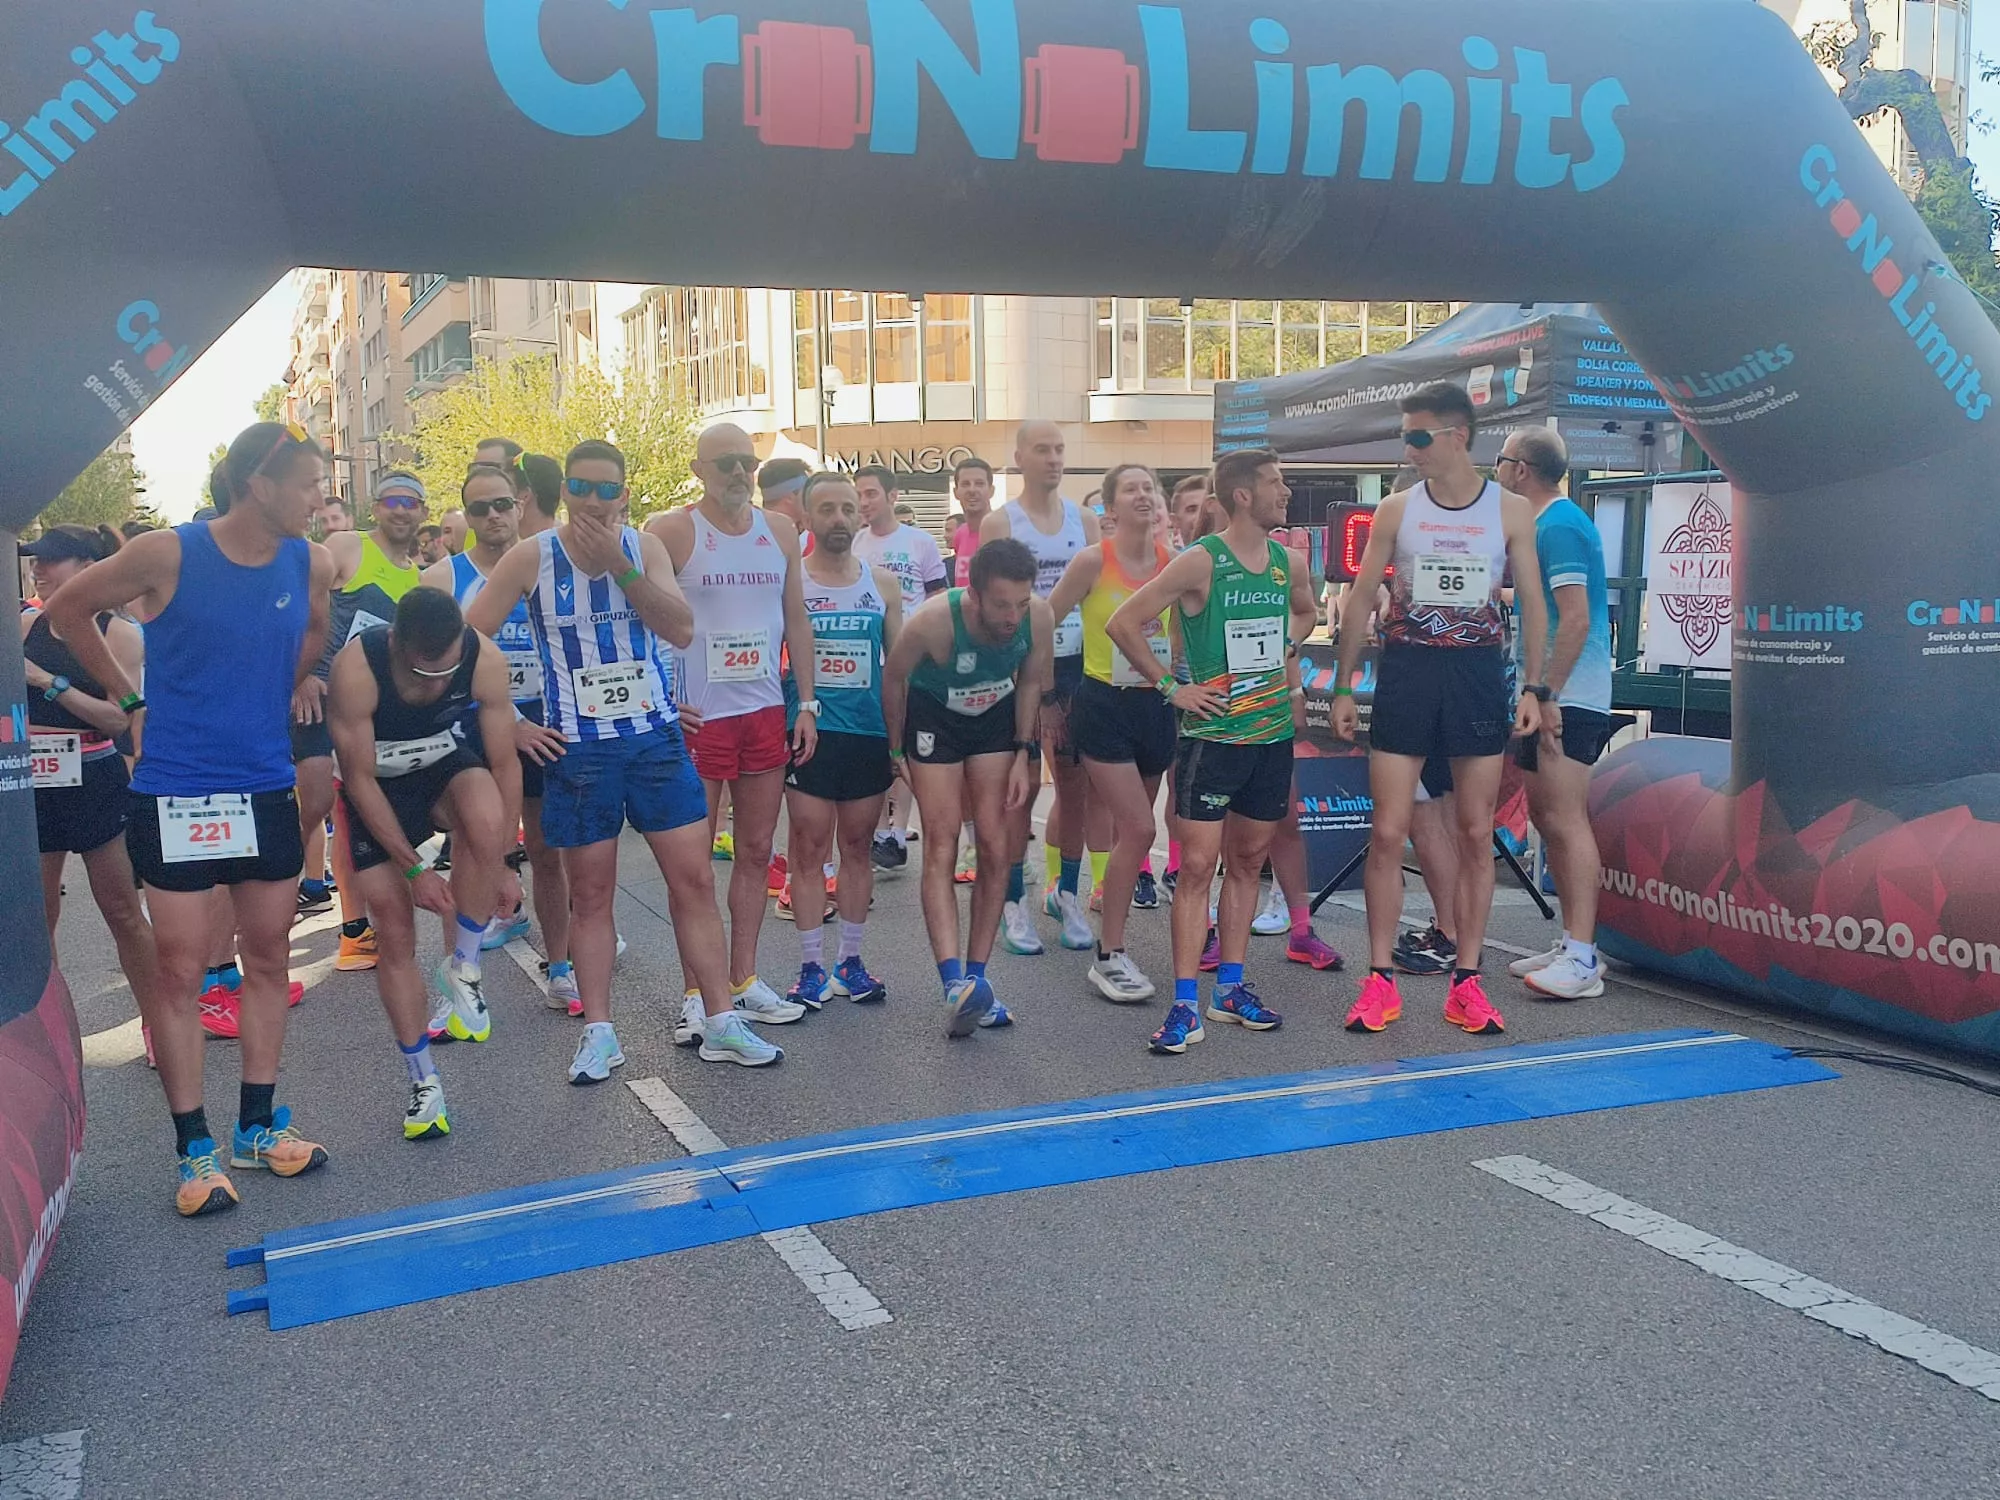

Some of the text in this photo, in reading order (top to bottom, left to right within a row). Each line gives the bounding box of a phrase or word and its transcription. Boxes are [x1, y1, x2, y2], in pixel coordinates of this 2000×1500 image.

[1582, 340, 1621, 353] VALLAS
[1577, 357, 1610, 371] BOLSA
[1576, 375, 1656, 392] SPEAKER Y SON
[1285, 378, 1446, 419] www.cronolimits2020.
[1568, 393, 1613, 407] TROFEOS
[1614, 396, 1623, 408] Y
[1735, 390, 1799, 422] deportivos
[825, 446, 974, 474] MANGO
[1438, 575, 1465, 591] 86
[1224, 590, 1285, 607] Huesca
[1928, 631, 1966, 641] Servicio
[1968, 631, 1980, 640] de
[1257, 641, 1265, 656] 1
[1823, 641, 1832, 651] y
[1922, 643, 1959, 656] gestión
[1962, 644, 1974, 653] de
[724, 650, 760, 667] 249
[821, 659, 857, 673] 250
[1786, 653, 1845, 666] deportivos
[603, 687, 630, 704] 29
[409, 758, 423, 771] 2
[189, 822, 231, 842] 221
